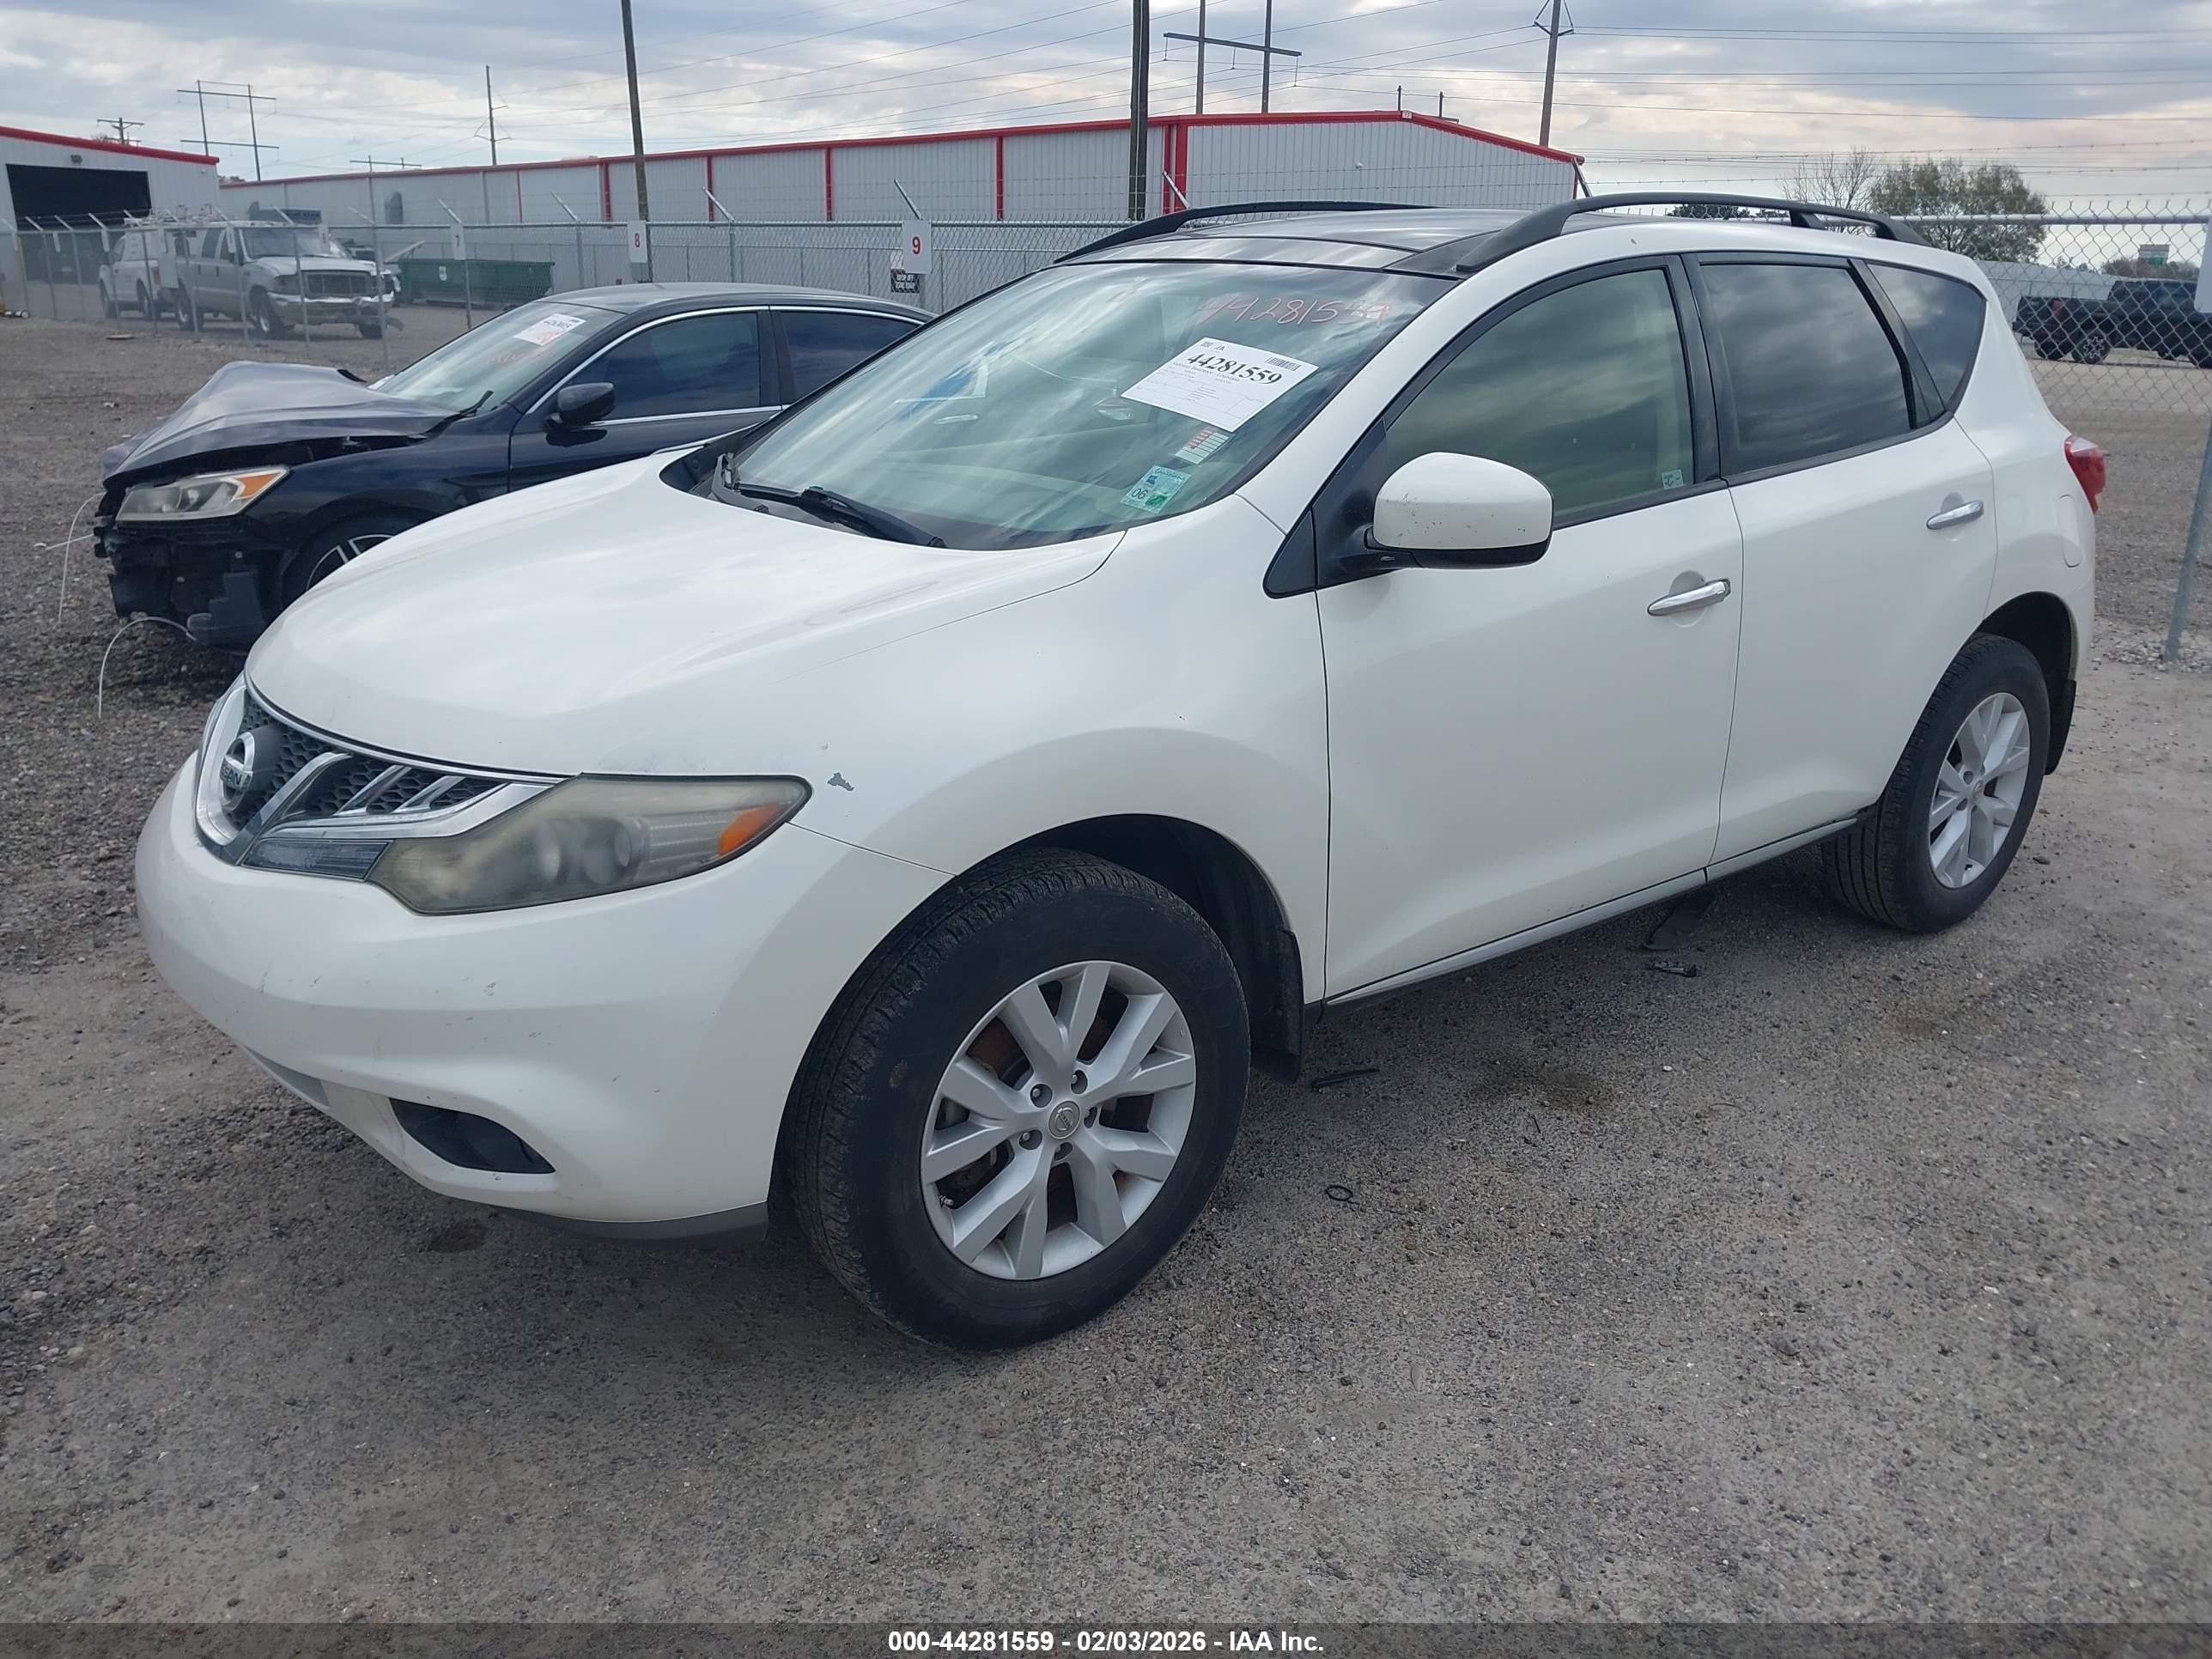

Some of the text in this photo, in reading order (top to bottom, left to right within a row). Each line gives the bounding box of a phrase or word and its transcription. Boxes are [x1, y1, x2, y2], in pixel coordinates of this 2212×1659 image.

[634, 233, 641, 248] 8
[912, 235, 921, 255] 9
[1187, 353, 1283, 385] 44281559
[1131, 488, 1148, 500] 06
